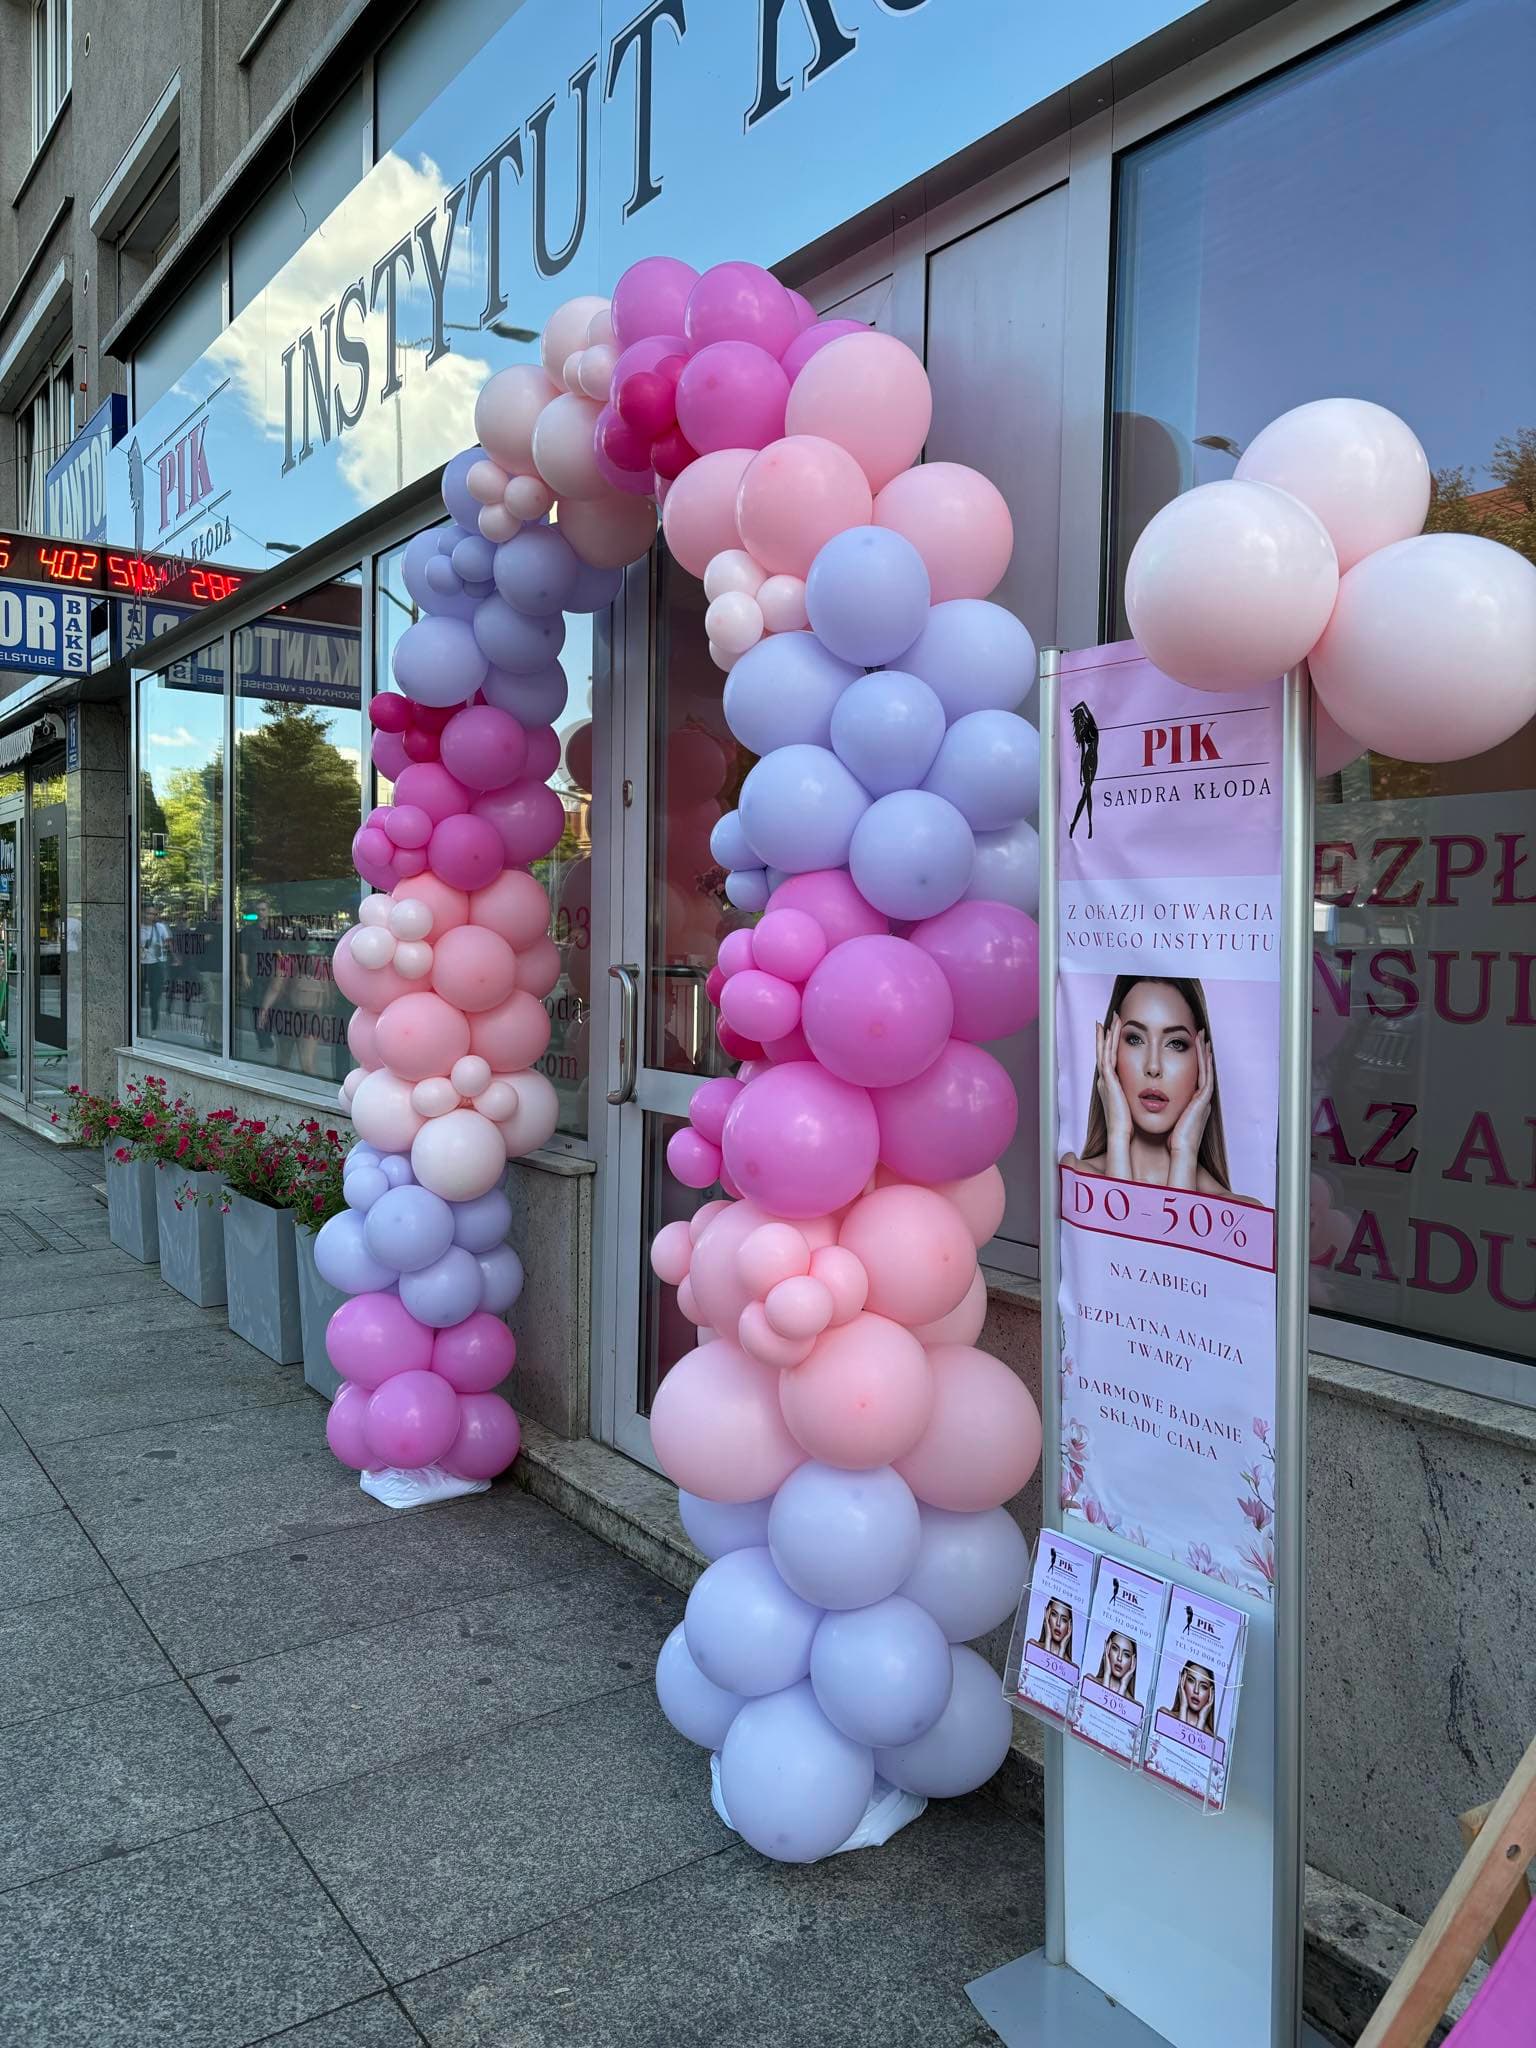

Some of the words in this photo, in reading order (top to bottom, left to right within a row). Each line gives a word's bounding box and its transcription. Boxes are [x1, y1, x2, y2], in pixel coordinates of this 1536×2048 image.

[281, 0, 686, 478] INSTYTUT
[158, 415, 214, 535] PIK
[65, 599, 83, 668] BAKS
[1141, 721, 1223, 768] PIK
[1103, 785, 1180, 807] SANDRA
[1194, 778, 1271, 800] KŁODA
[1067, 904, 1076, 920] Z
[1084, 904, 1145, 922] OKAZJI
[1153, 903, 1273, 922] OTWARCIA
[1066, 931, 1143, 949] NOWEGO
[1153, 932, 1274, 951] INSTYTUTU
[1109, 1261, 1133, 1280] NA
[1138, 1268, 1208, 1298] ZABIEGI
[1127, 1339, 1193, 1373] TWARZY
[1175, 1328, 1244, 1365] ANALIZA
[1078, 1375, 1164, 1415] DARMOWE
[1168, 1403, 1243, 1444] BADANIE
[1122, 1590, 1139, 1605] PIK
[1197, 1618, 1215, 1634] PIK
